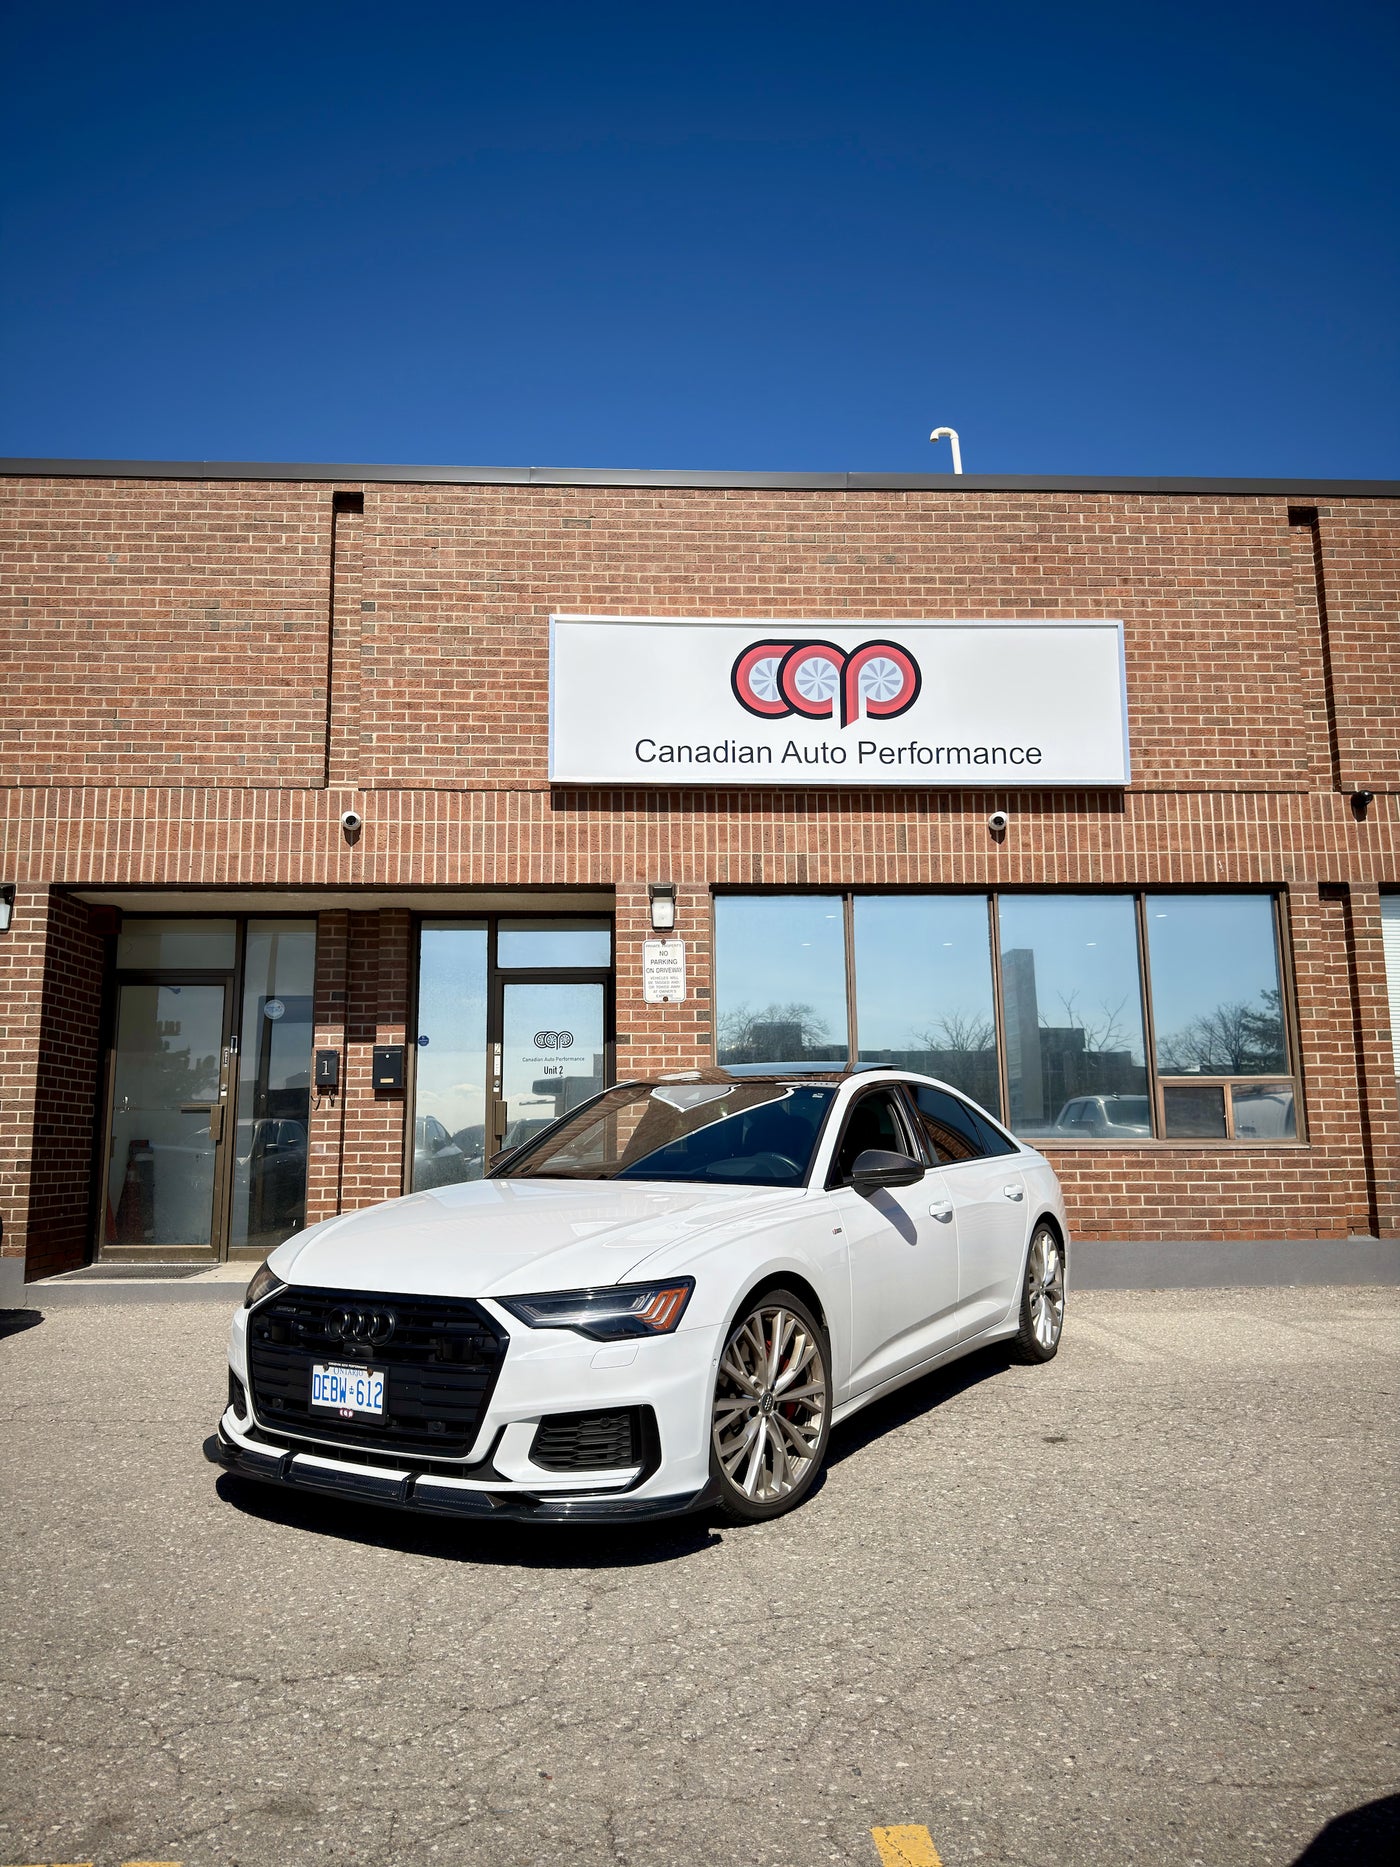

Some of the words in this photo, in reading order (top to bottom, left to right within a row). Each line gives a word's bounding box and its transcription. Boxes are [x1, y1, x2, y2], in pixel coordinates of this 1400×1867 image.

[635, 738, 772, 764] Canadian
[782, 740, 847, 764] Auto
[858, 741, 1042, 765] Performance
[321, 1060, 330, 1076] 1
[543, 1065, 557, 1074] Unit
[559, 1065, 563, 1074] 2
